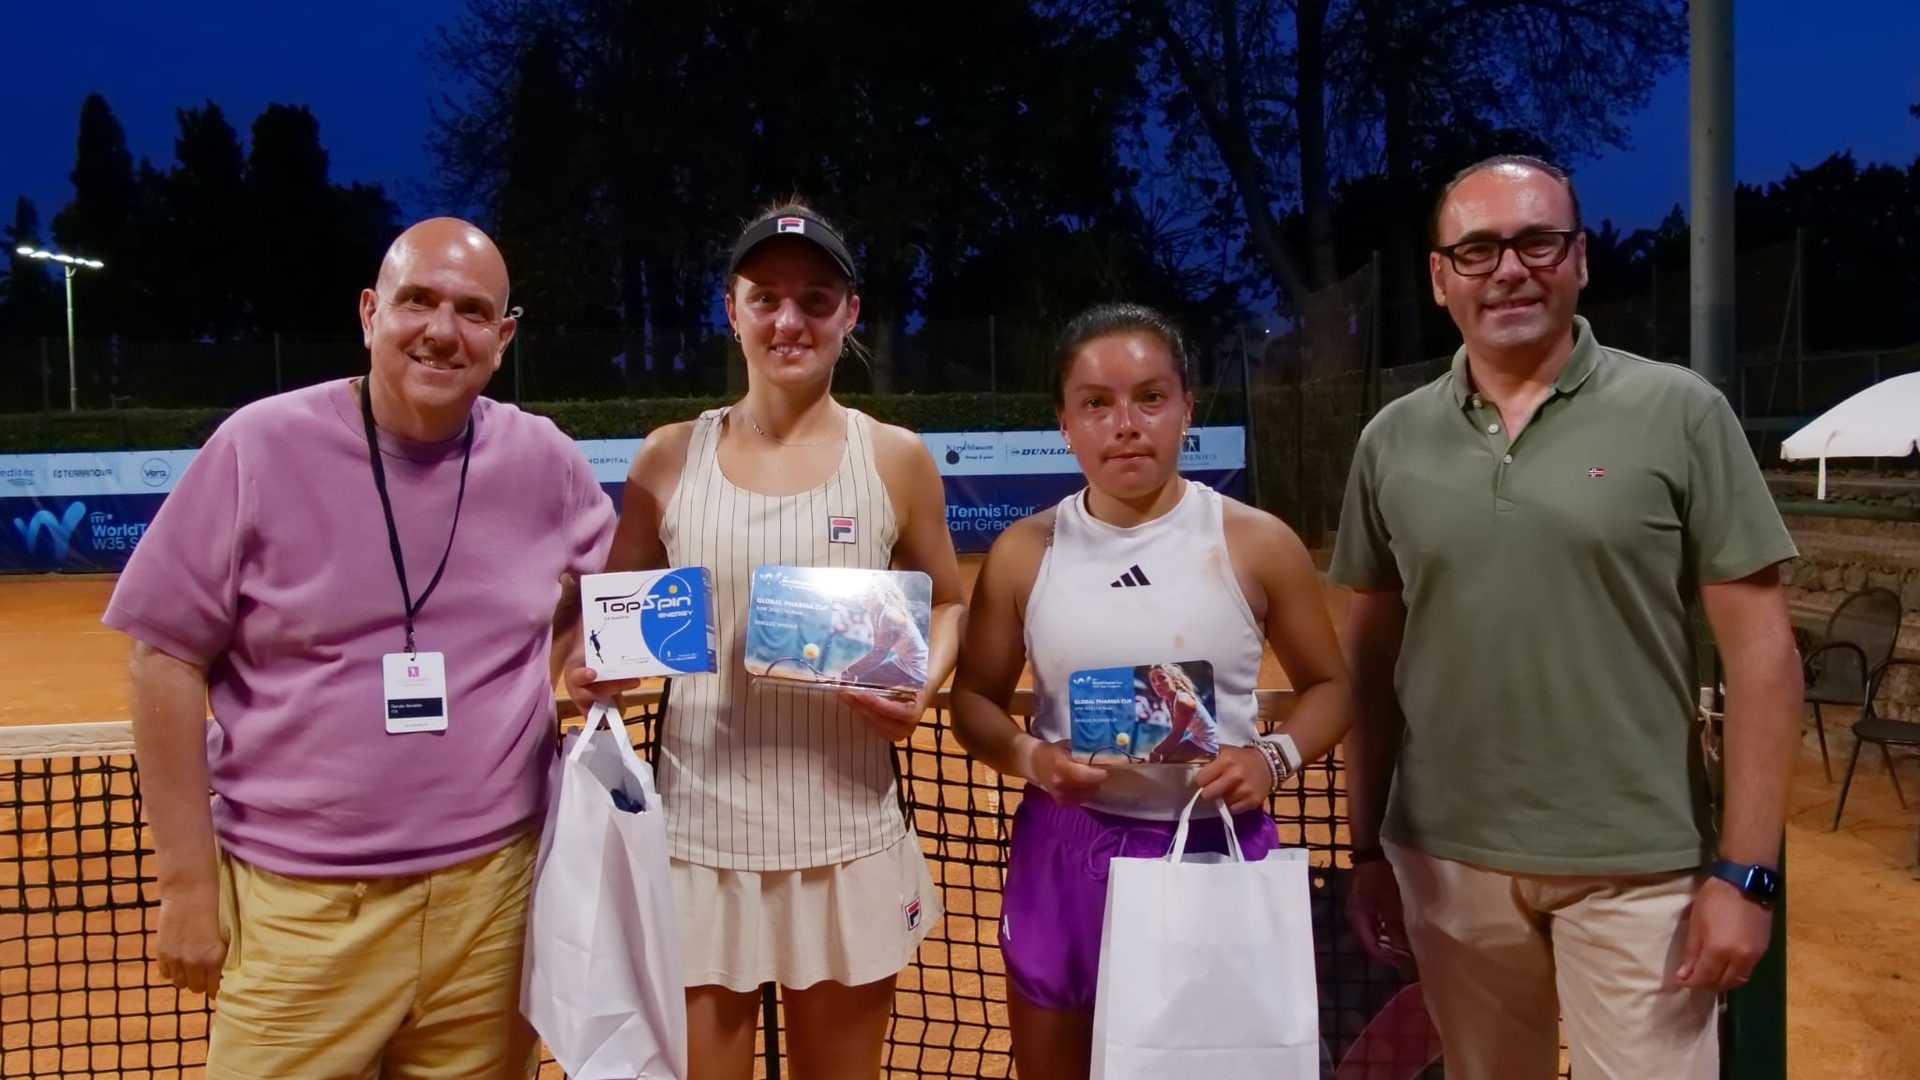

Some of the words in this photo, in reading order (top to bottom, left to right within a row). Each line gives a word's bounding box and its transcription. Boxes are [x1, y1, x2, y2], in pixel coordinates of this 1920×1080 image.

[946, 519, 970, 531] an
[92, 537, 126, 550] W35
[757, 597, 782, 606] GLOBAL
[784, 600, 814, 610] PHARMA
